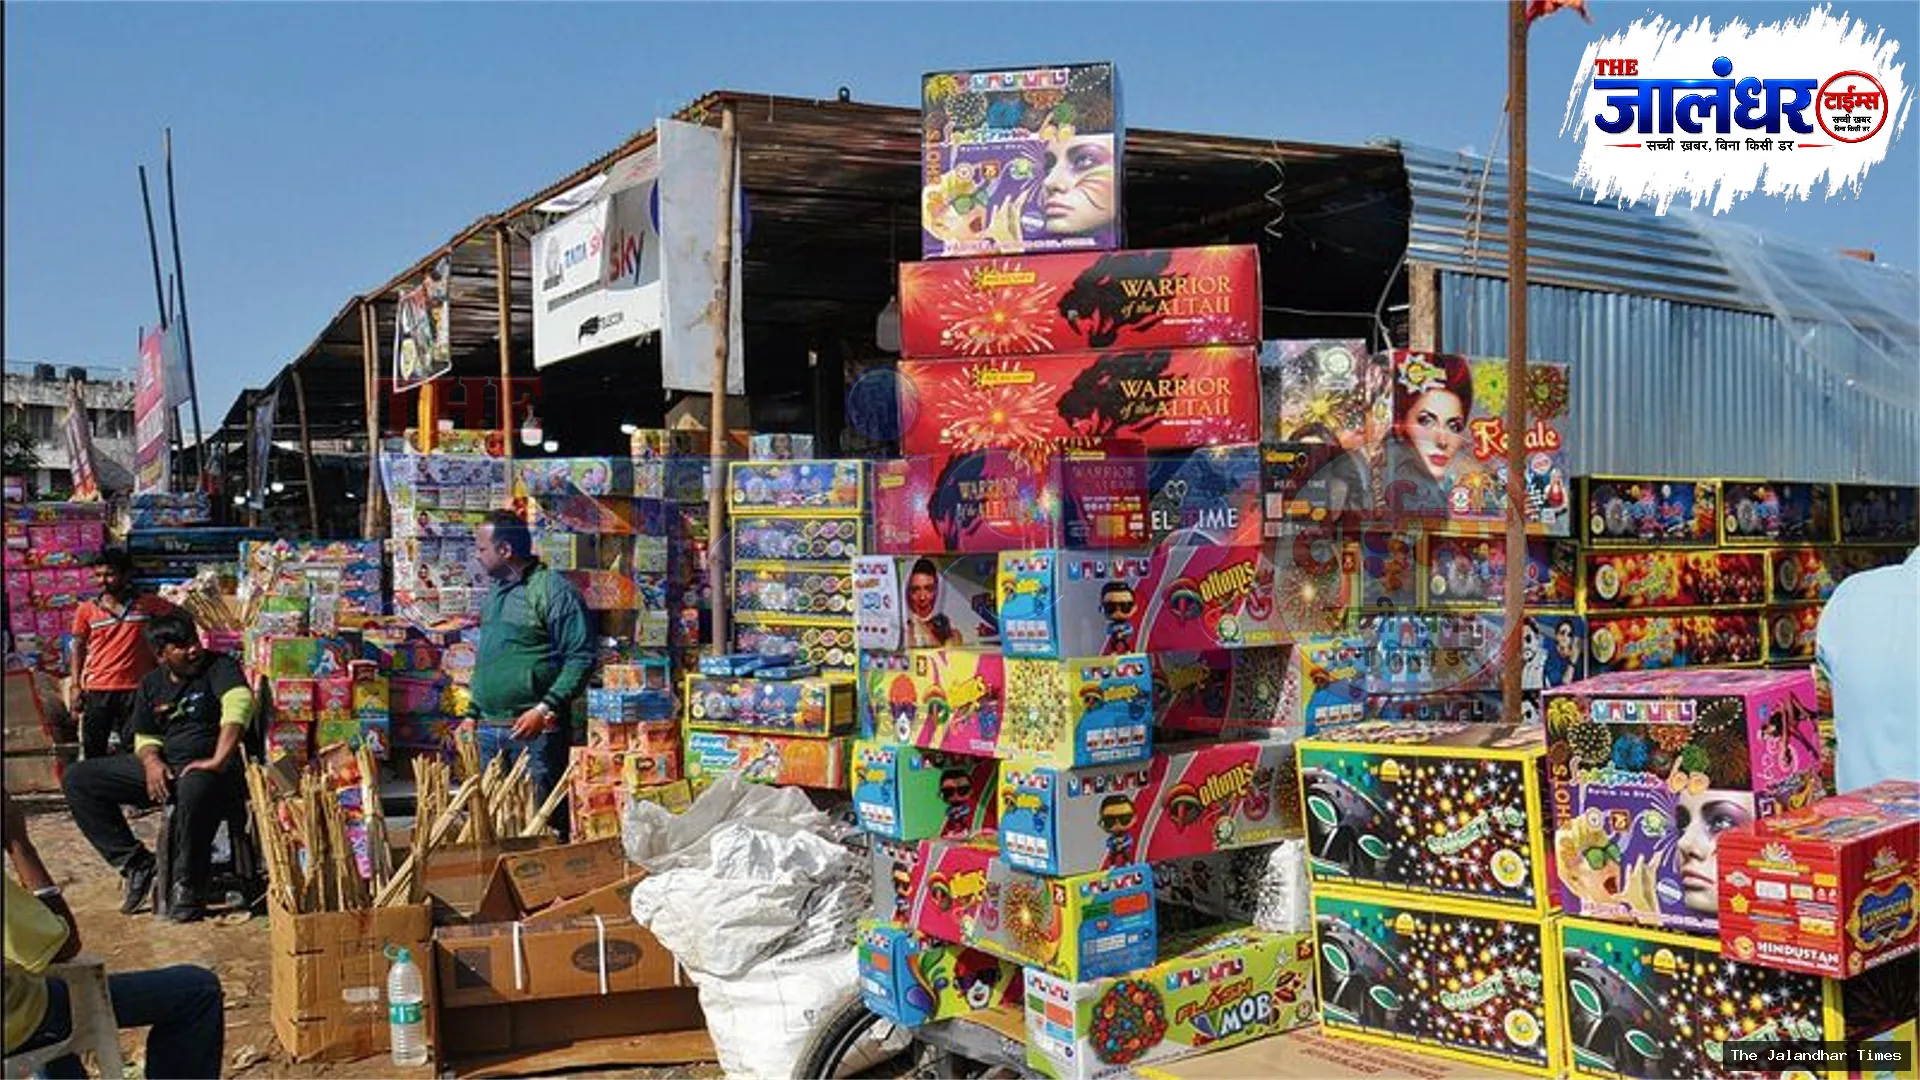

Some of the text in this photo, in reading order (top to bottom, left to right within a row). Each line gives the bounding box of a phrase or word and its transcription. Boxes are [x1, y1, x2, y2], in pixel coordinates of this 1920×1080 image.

[1120, 276, 1232, 299] WARRIOR
[1120, 301, 1135, 318] of
[1135, 302, 1154, 315] the
[1119, 377, 1232, 399] WARRIOR
[1119, 401, 1134, 418] of
[1134, 401, 1154, 415] the
[1470, 419, 1557, 457] Roale
[1151, 510, 1174, 531] EL
[1756, 941, 1840, 965] HINDUSTAN
[1218, 991, 1273, 1038] MOB
